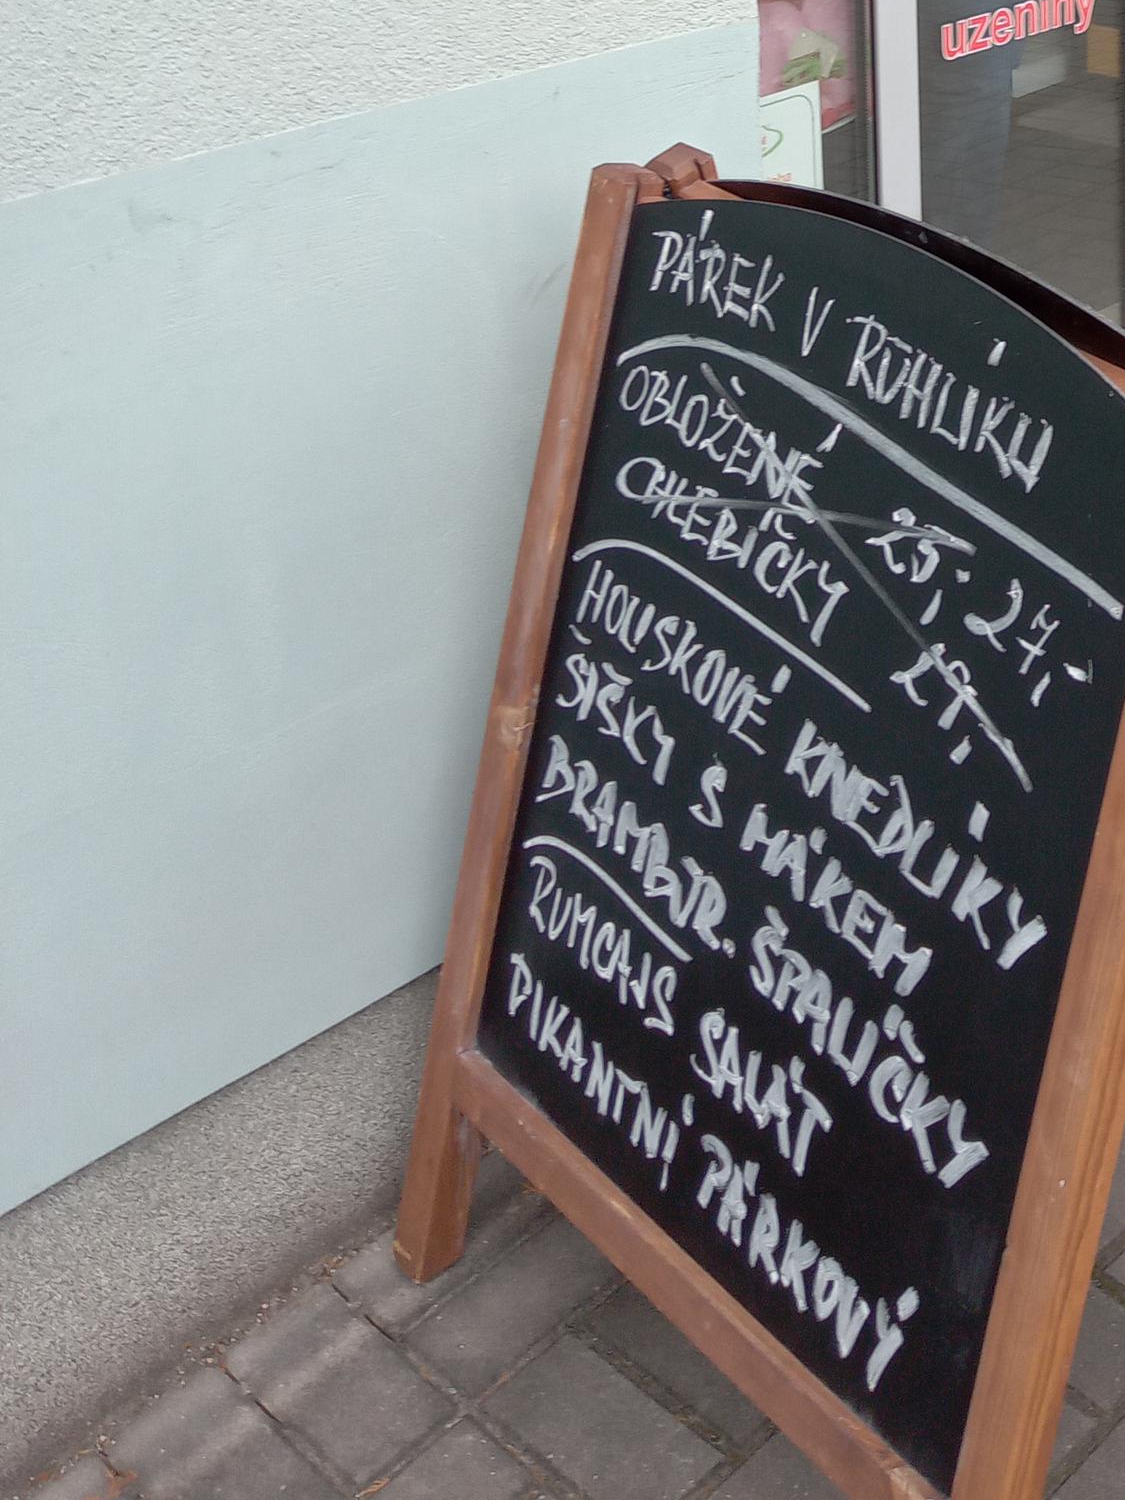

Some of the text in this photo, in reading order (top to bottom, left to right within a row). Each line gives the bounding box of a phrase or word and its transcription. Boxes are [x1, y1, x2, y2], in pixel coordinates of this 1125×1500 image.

[650, 210, 785, 331] PÁREK
[801, 286, 836, 357] V
[615, 456, 850, 647] CHLEBÍČKY
[619, 365, 843, 525] OBLOŽENÉ
[555, 624, 932, 997] ŠIŠKY S MÁKEM
[576, 559, 1049, 970] HOUSKOVÉ KNEDLÍKY
[530, 855, 833, 1177] RUMCAJS SALÁT
[749, 904, 990, 1190] ŠPALÍČKY
[508, 952, 920, 1392] PIKANTNÍ PÁRKOVÝ
